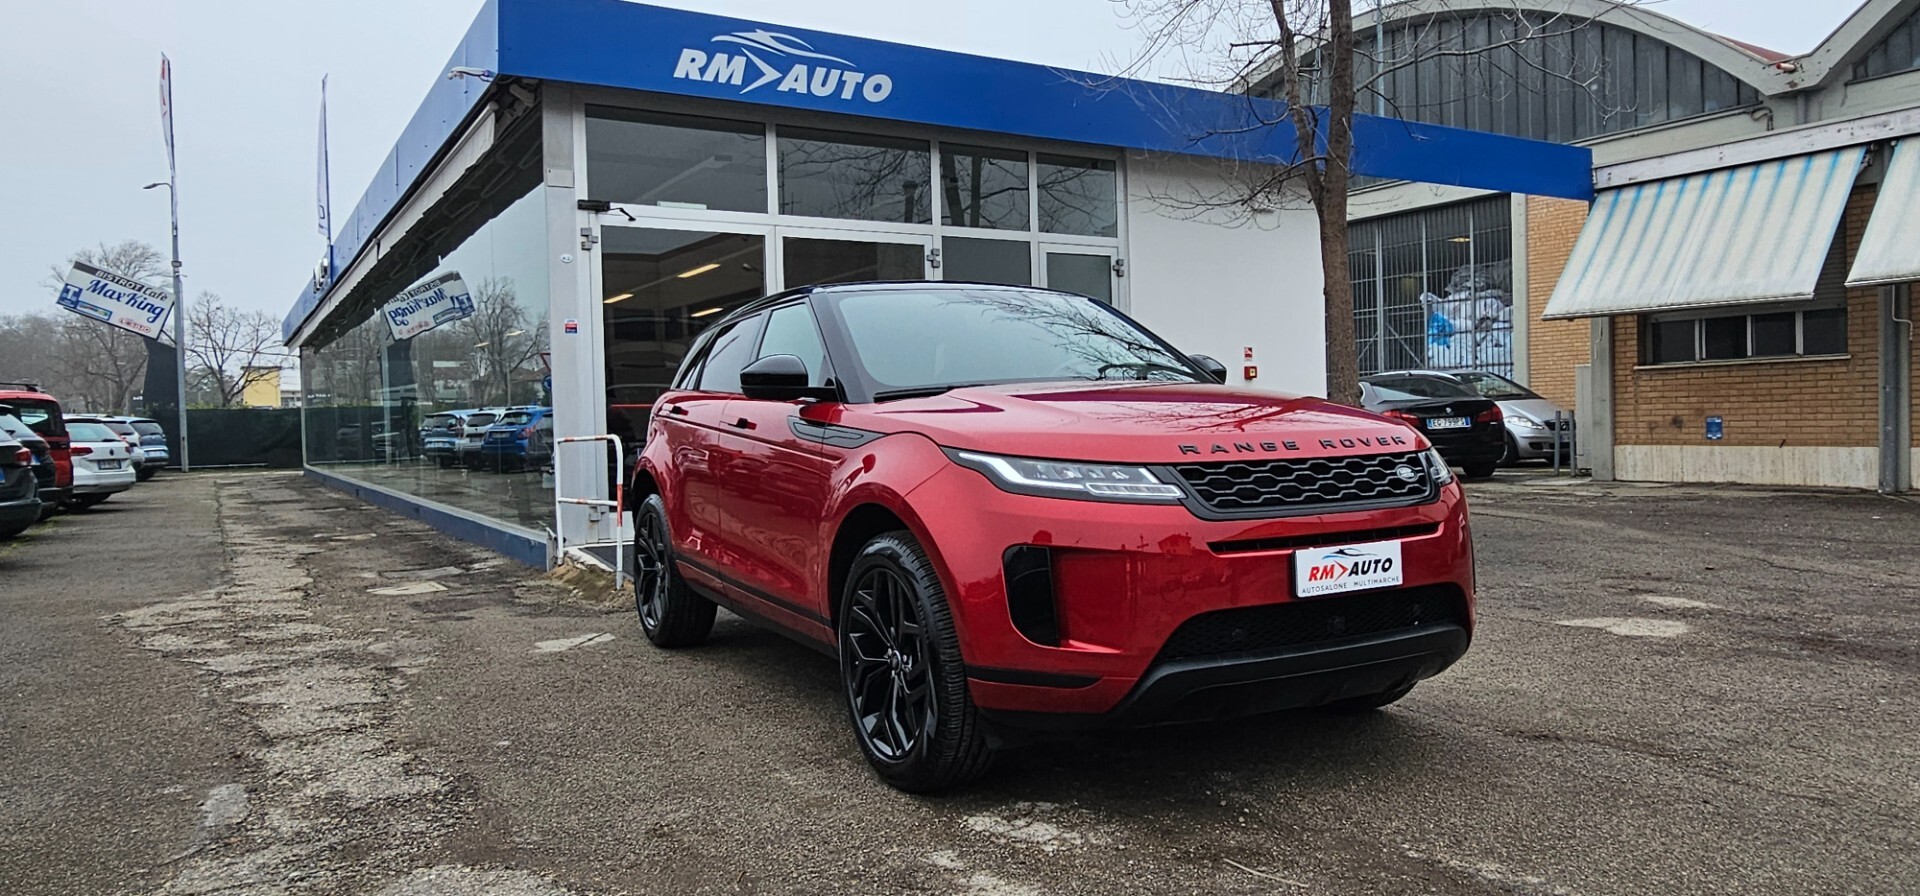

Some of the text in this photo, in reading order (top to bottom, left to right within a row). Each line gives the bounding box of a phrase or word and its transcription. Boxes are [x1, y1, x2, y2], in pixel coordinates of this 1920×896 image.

[673, 48, 893, 103] RM AUTO
[95, 270, 142, 292] BISTROT
[1178, 435, 1407, 455] RANGE ROVER
[1308, 557, 1393, 582] RM AUTO
[1302, 576, 1400, 594] AUTOSALONE MULTIMARCHE
